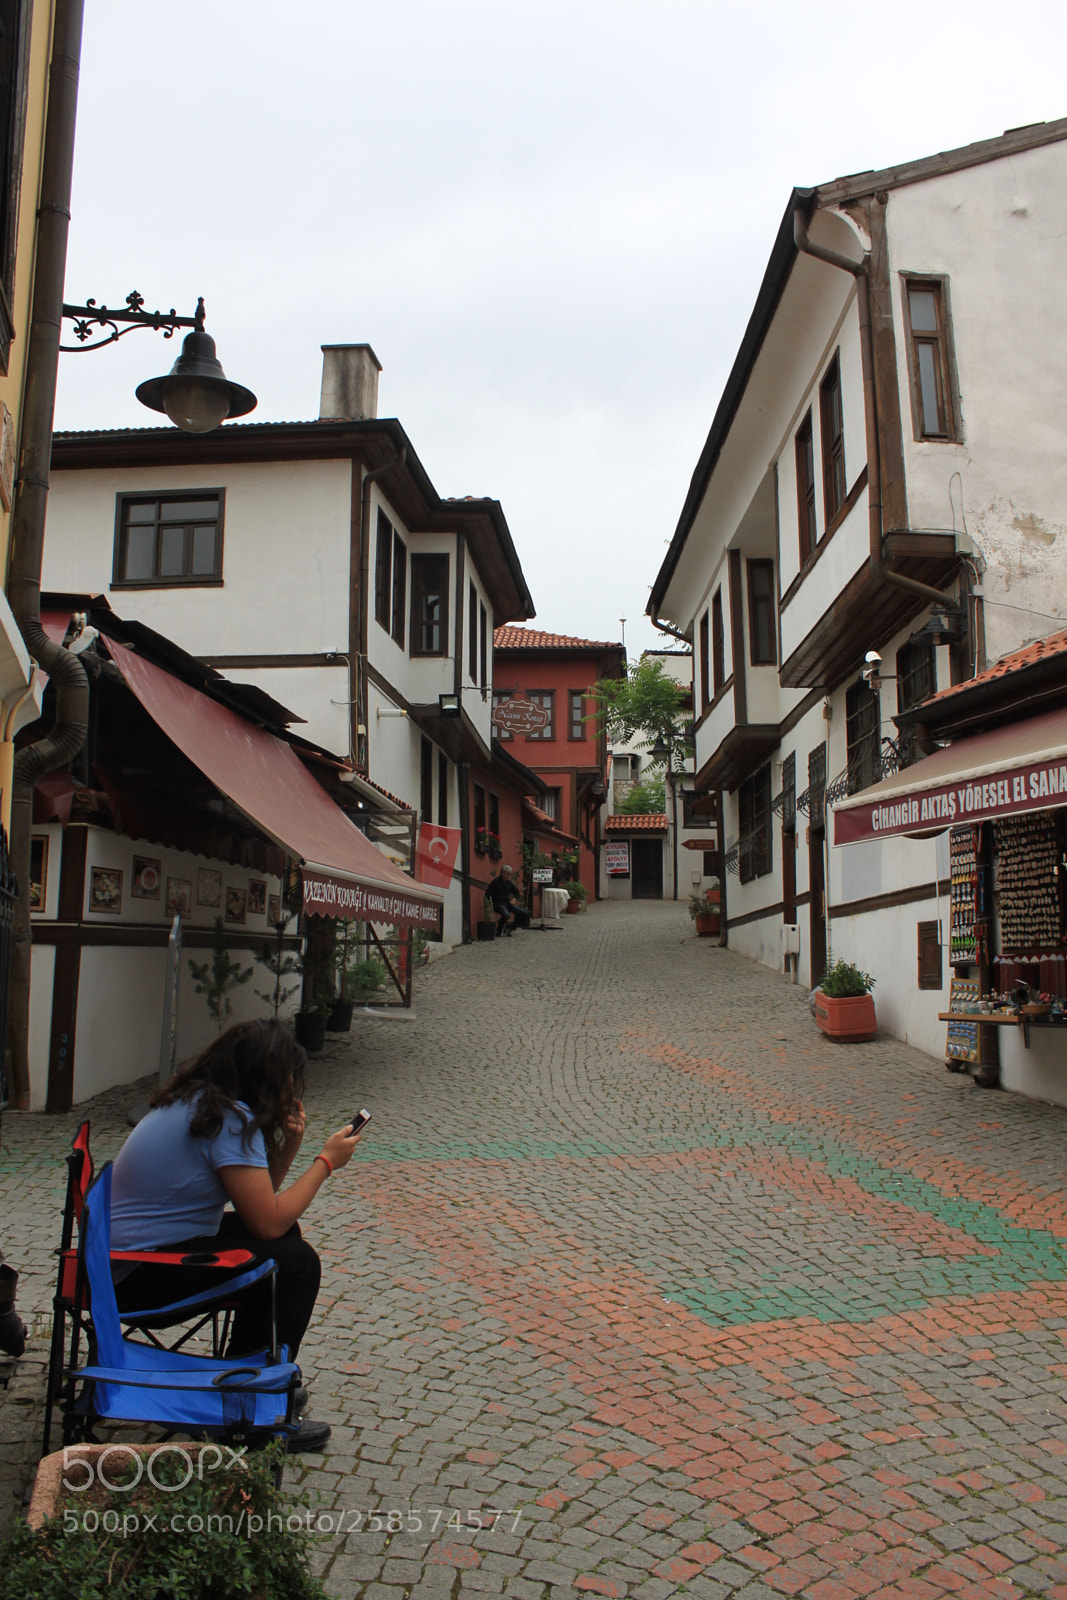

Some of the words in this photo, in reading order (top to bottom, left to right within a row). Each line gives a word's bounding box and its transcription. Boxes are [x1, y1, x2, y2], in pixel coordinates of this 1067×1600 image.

[871, 797, 920, 831] CİHANGİR
[920, 791, 957, 820] AKTAŞ
[958, 779, 1011, 813] YÖRESEL
[1012, 775, 1028, 803] EL
[337, 885, 363, 913] KONAĞI
[367, 893, 390, 913] KAHVALTI
[405, 902, 420, 919] KAHVE
